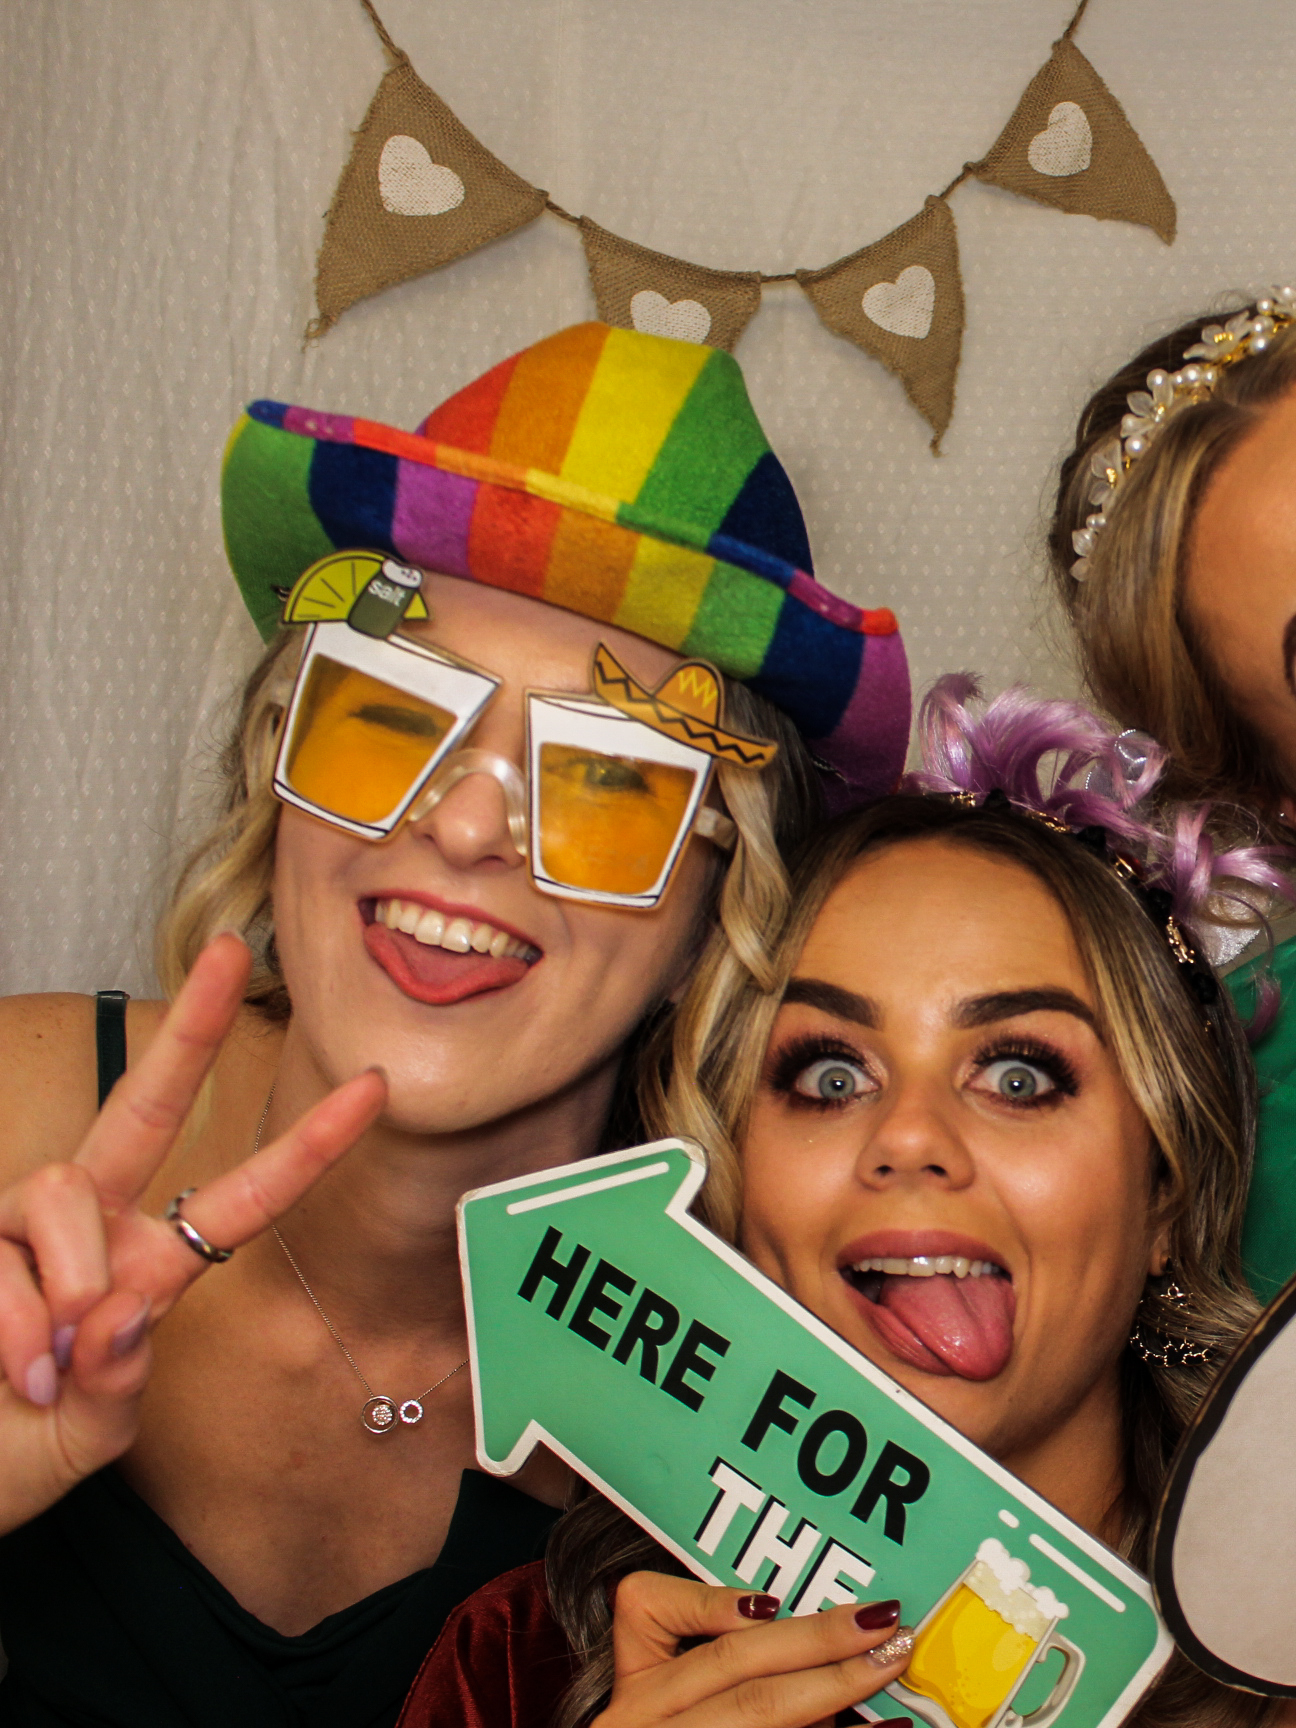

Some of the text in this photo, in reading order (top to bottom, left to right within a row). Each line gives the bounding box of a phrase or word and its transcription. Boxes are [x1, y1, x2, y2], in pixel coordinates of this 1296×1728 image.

[369, 580, 405, 606] salt
[517, 1225, 931, 1546] HERE FOR
